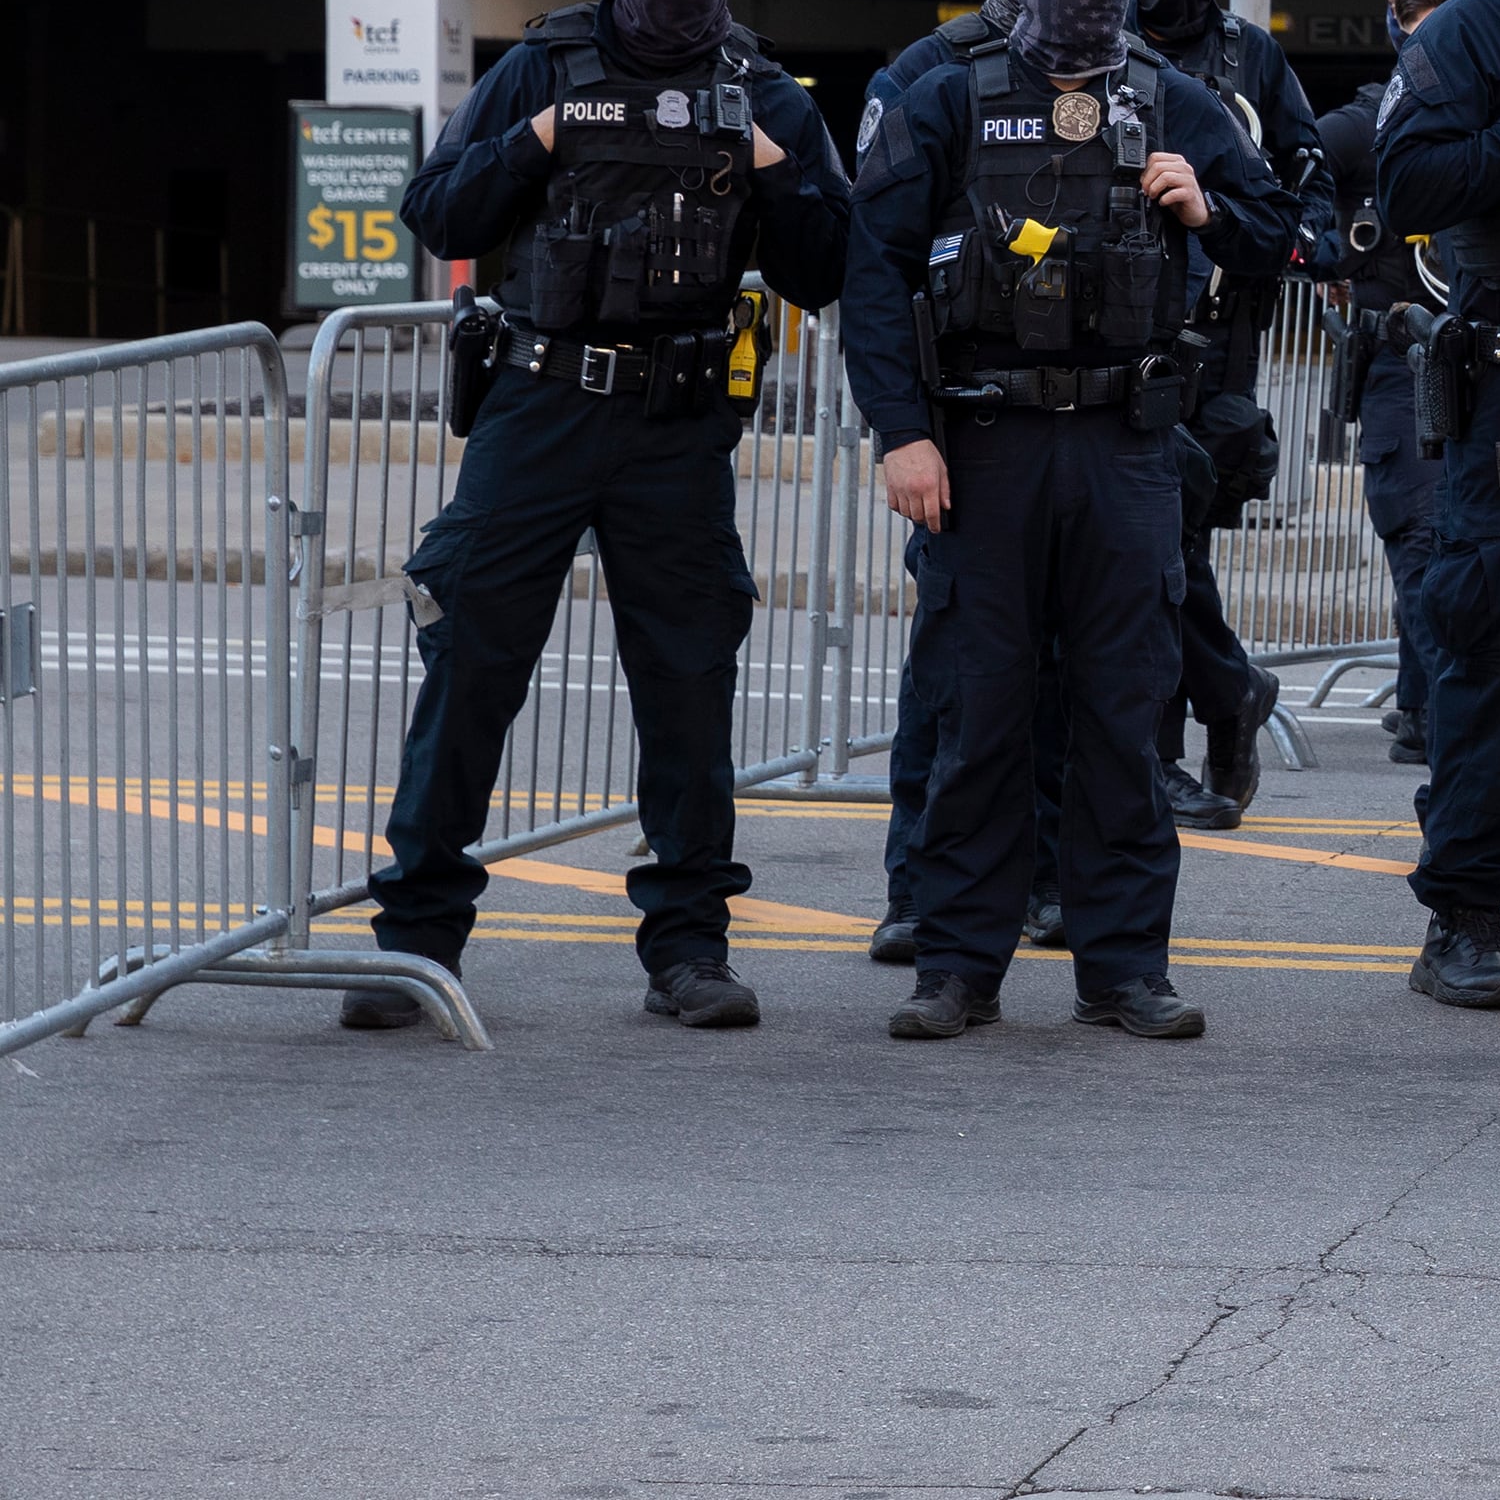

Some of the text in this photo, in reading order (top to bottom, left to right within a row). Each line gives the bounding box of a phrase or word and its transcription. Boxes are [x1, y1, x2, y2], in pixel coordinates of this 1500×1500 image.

[364, 18, 400, 45] tcf
[343, 68, 421, 85] PARKING
[563, 102, 626, 122] POLICE
[311, 120, 411, 145] tcf CENTER
[984, 118, 1043, 142] POLICE
[302, 154, 408, 170] WASHINGTON
[307, 170, 404, 187] BOULEVARD
[321, 186, 388, 203] GARAGE
[307, 202, 399, 262] $15
[298, 262, 409, 280] CREDIT CARD
[332, 279, 380, 296] ONLY
